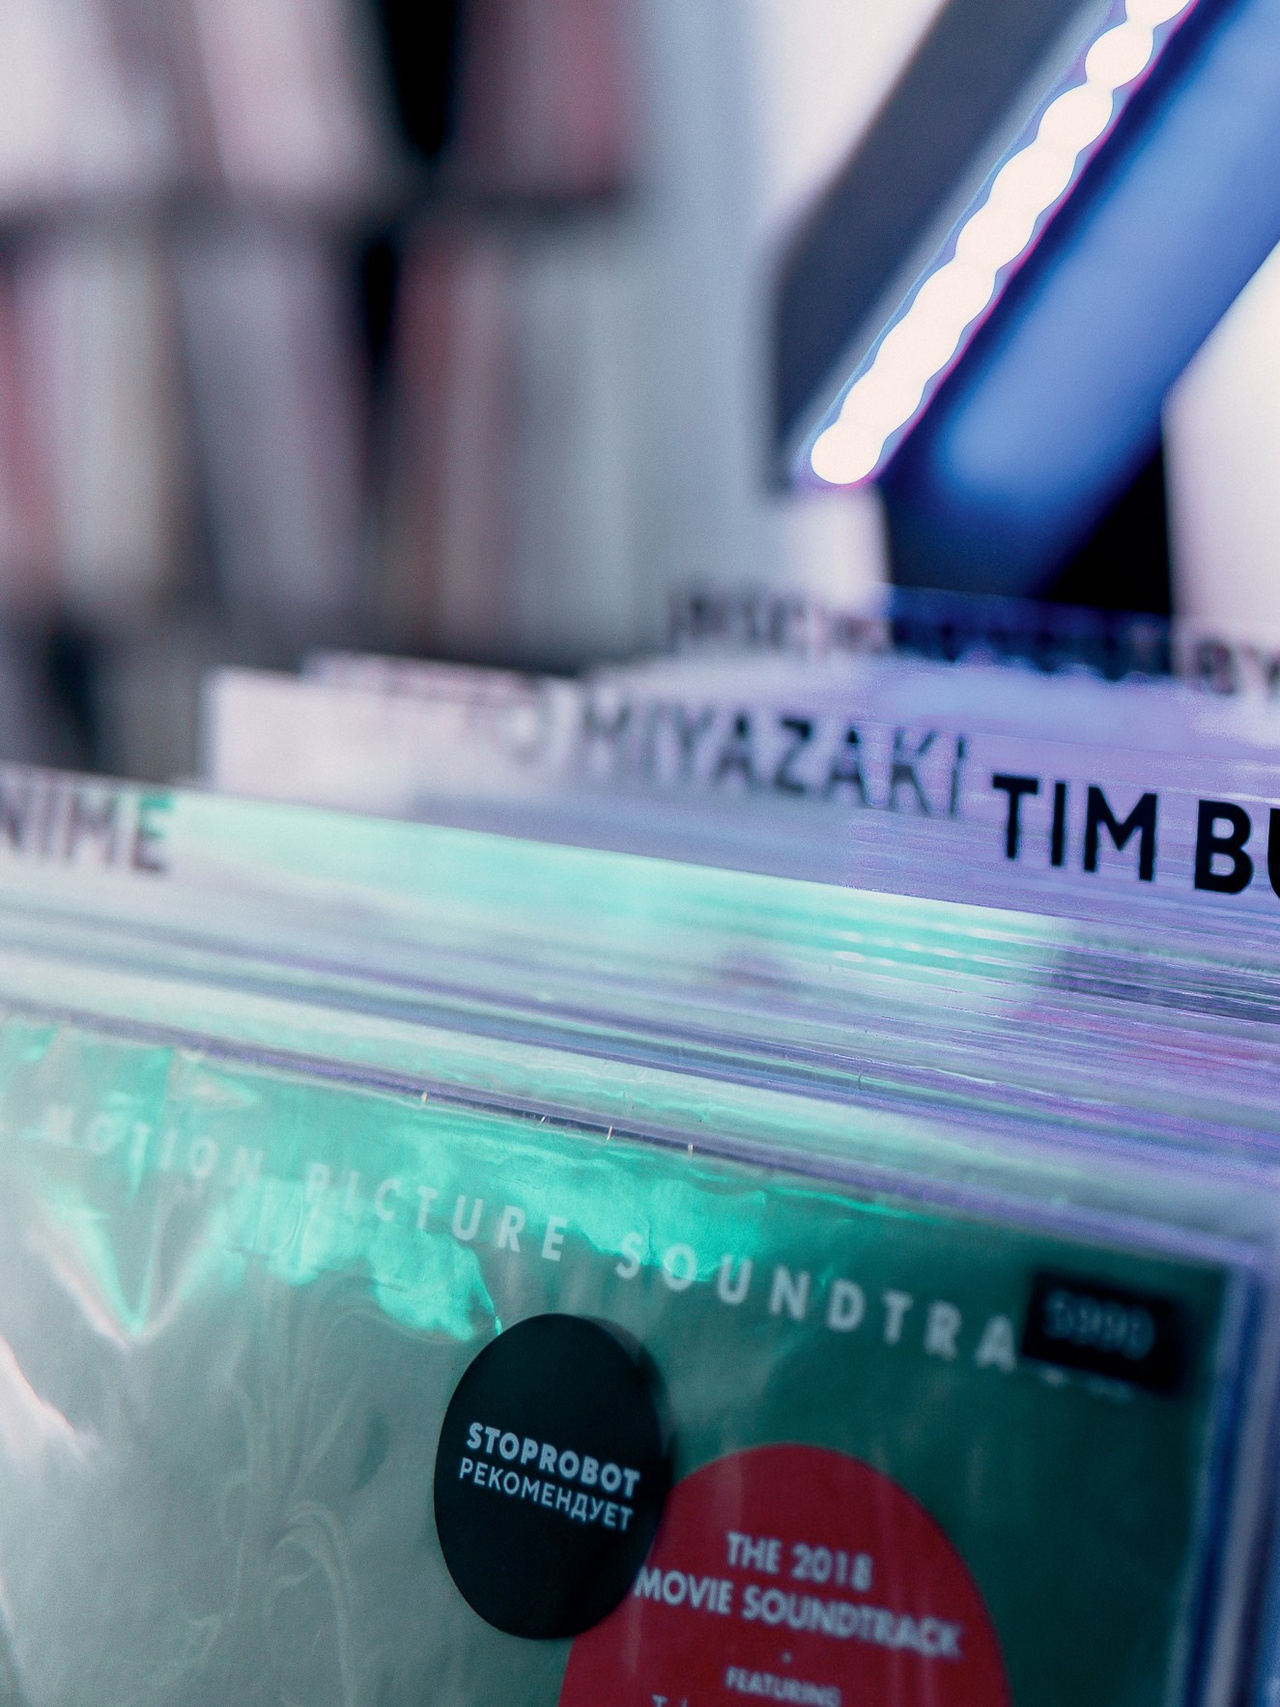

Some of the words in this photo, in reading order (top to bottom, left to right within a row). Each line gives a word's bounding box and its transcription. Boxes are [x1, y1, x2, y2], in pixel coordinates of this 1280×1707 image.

[580, 690, 970, 818] MIYAZAKI
[991, 772, 1160, 884] TIM
[304, 1162, 568, 1263] PICTURE
[615, 1230, 1132, 1402] SOUNDTRA
[458, 1456, 634, 1532] РЕКОМЕНДУЕТ
[466, 1421, 641, 1499] STOPROBOT
[727, 1530, 782, 1576] THE
[791, 1542, 874, 1593] 2018
[634, 1565, 735, 1626] MOVIE
[742, 1584, 965, 1662] SOUNDTRACK
[725, 1665, 842, 1707] FEATURING
